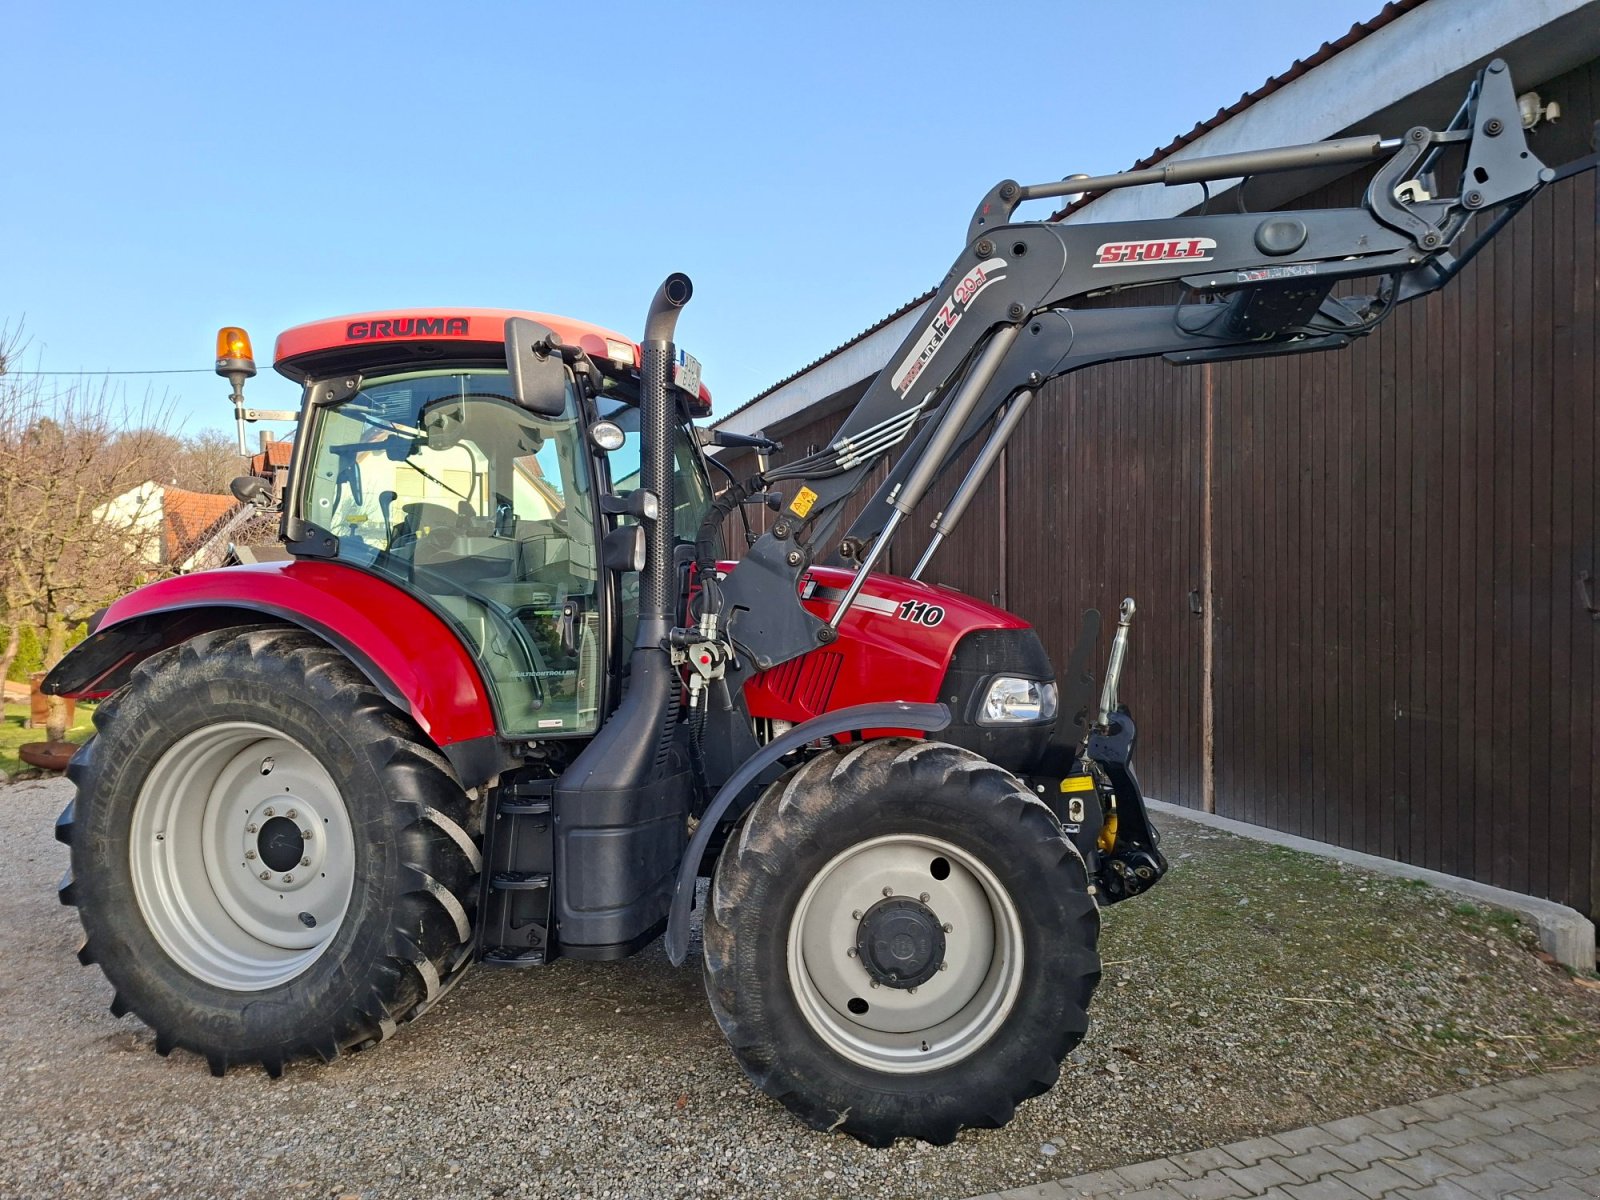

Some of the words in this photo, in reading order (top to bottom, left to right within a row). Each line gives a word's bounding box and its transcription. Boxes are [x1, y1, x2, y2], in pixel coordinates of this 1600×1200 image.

[1100, 240, 1205, 263] STOLL
[932, 306, 958, 337] FZ
[956, 267, 987, 304] 20.1
[347, 317, 469, 340] GRUMA
[899, 600, 945, 627] 110
